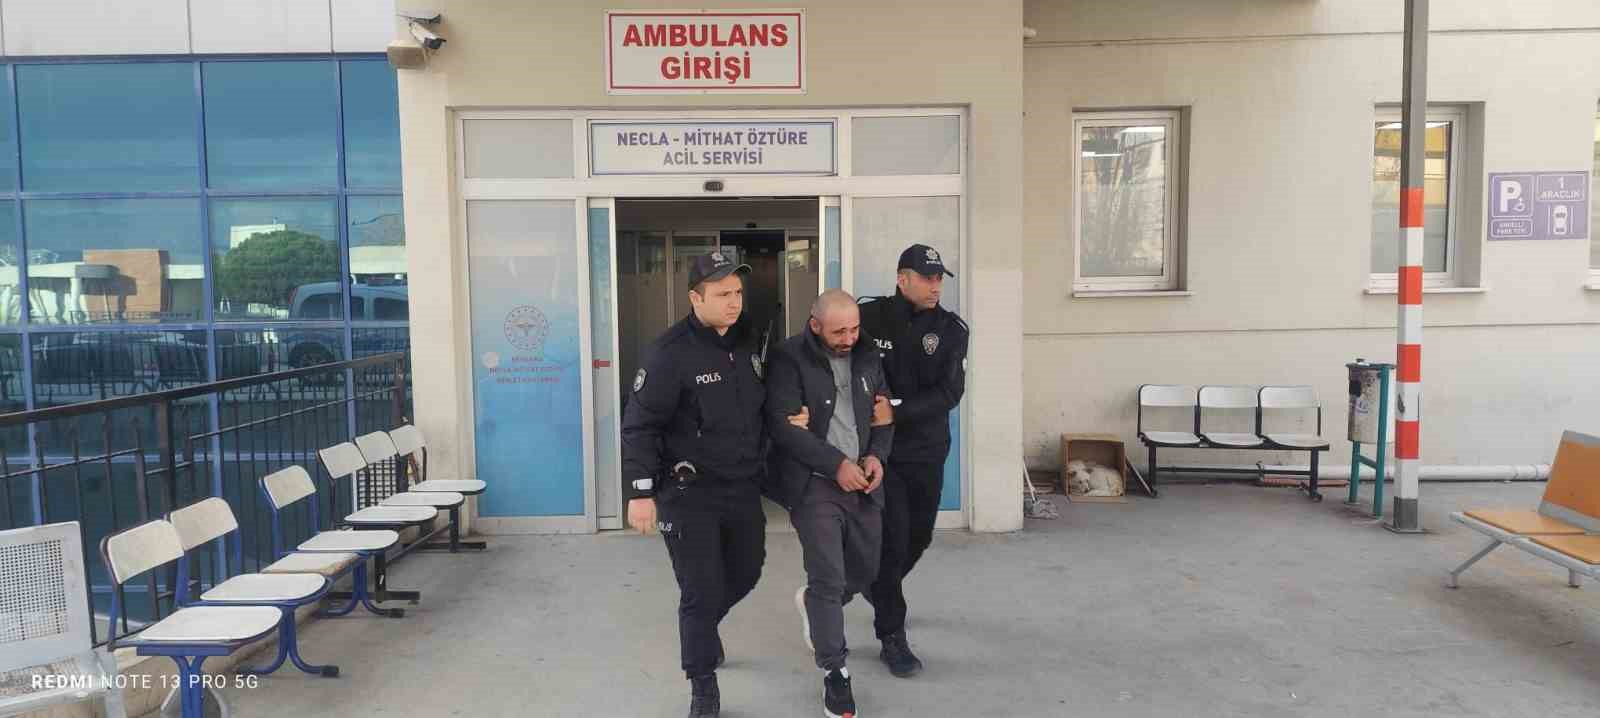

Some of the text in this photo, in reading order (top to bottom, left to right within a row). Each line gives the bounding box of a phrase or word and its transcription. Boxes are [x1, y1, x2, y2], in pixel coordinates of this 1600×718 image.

[622, 23, 789, 47] AMBULANS
[660, 50, 751, 84] GİRİŞİ
[617, 131, 669, 146] NECLA
[684, 128, 743, 146] MİTHAT
[747, 128, 808, 145] ÖZTÜRE
[663, 147, 763, 165] ACİL SERVİSİ
[1558, 176, 1565, 190] 1
[1500, 180, 1522, 213] P
